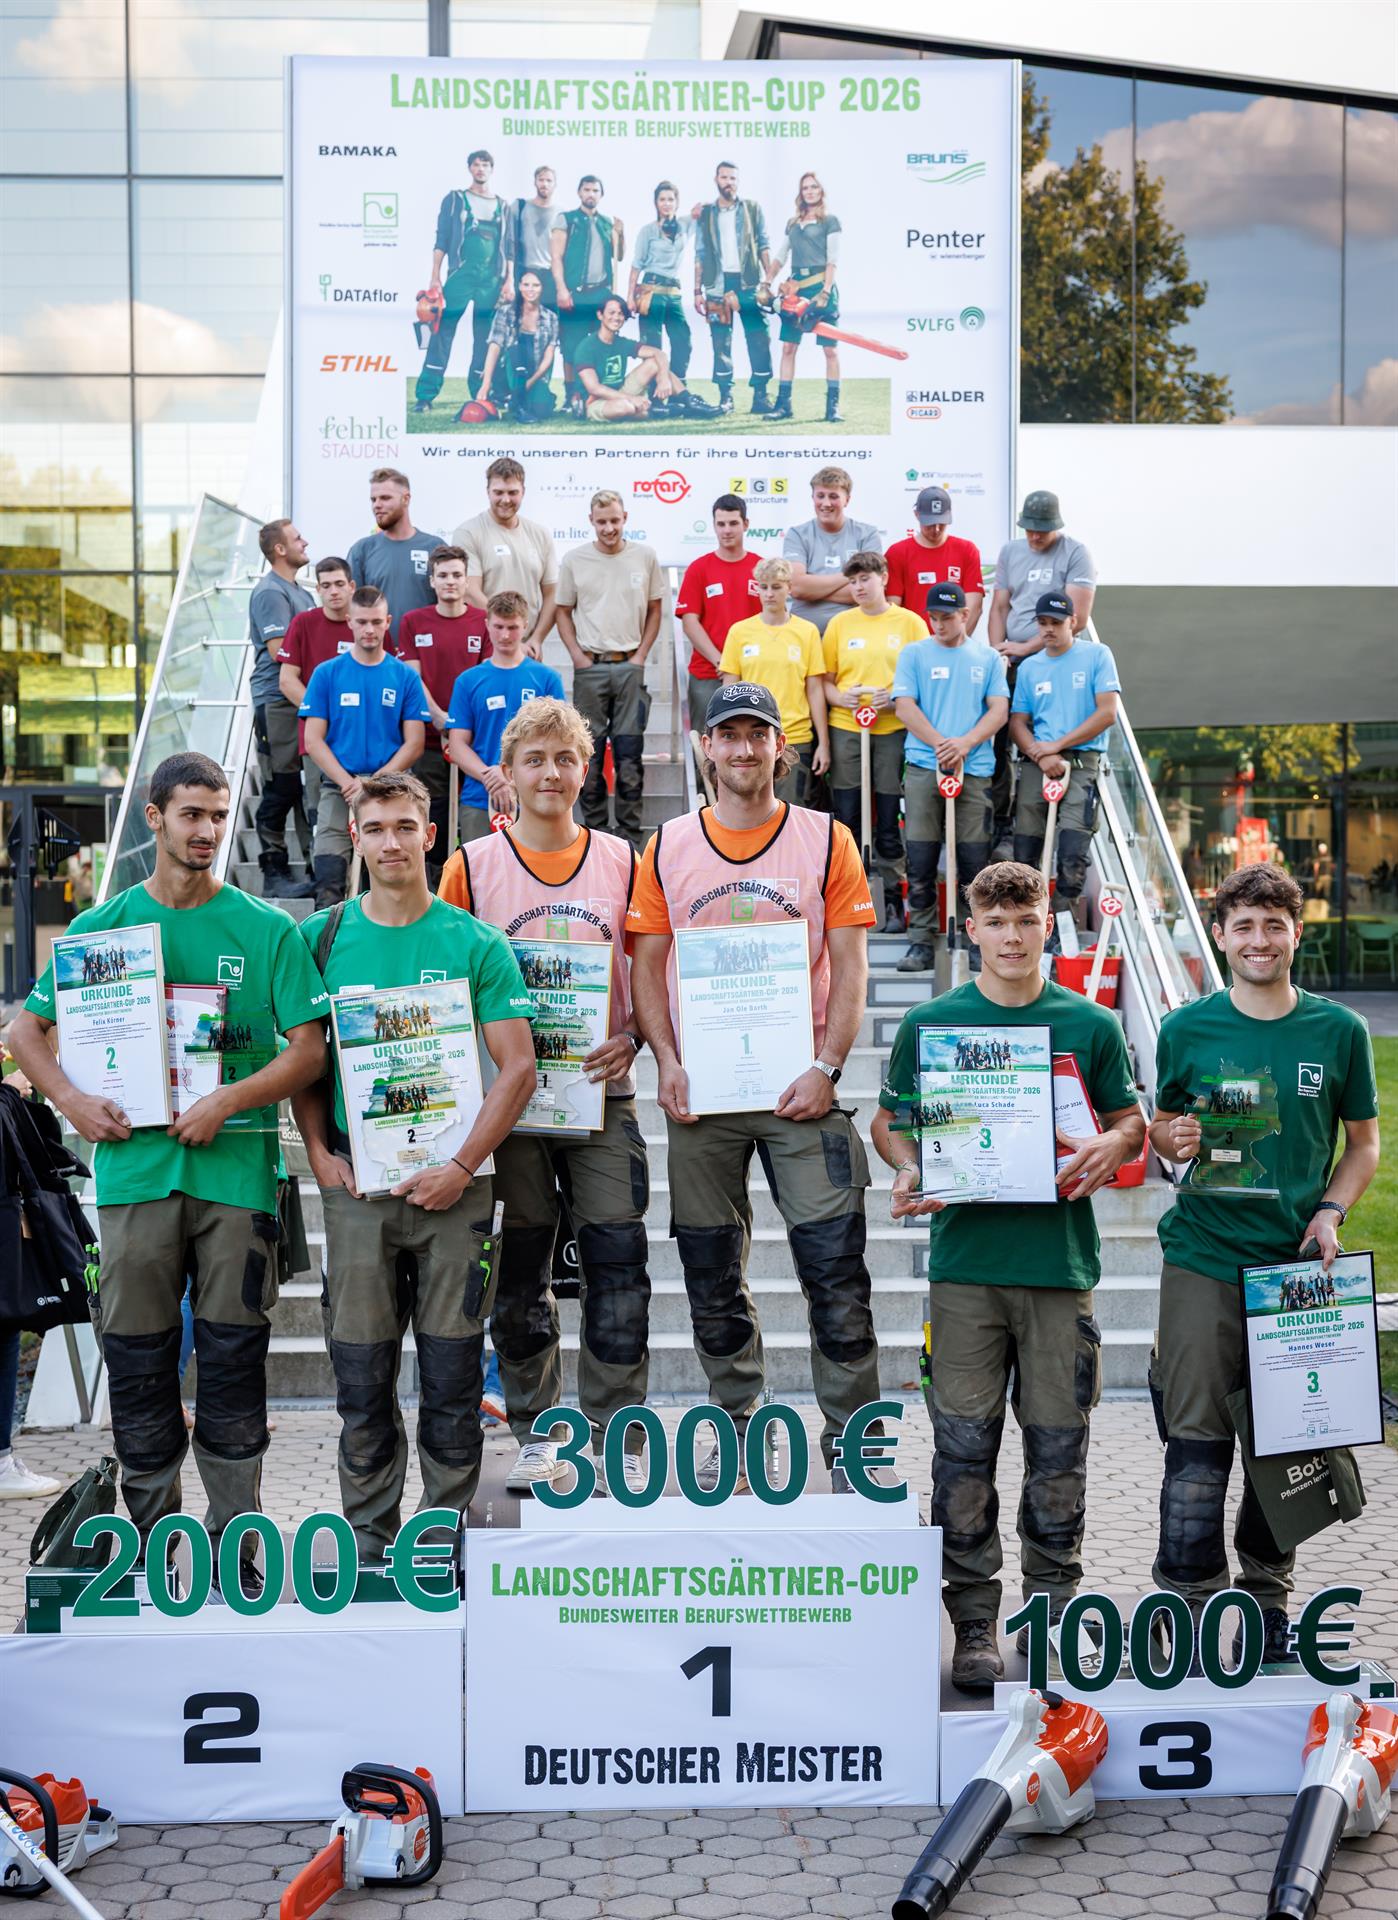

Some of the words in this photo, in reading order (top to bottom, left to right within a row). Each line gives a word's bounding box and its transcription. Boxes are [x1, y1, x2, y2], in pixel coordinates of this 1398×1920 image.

[390, 71, 825, 112] LANDSCHAFTSGÄRTNER-CUP
[839, 77, 921, 112] 2026
[502, 118, 628, 137] BUNDESWEITER
[635, 119, 811, 138] BERUFSWETTBEWERB
[318, 145, 398, 157] BAMAKA
[907, 229, 985, 248] Penter
[333, 289, 399, 303] DATAflor
[906, 318, 955, 332] SVLFG
[320, 355, 399, 373] STIHL
[919, 390, 985, 403] HALDER
[319, 416, 399, 440] fehrle
[321, 443, 399, 459] STAUDEN
[422, 446, 451, 458] Wir
[457, 447, 515, 459] danken
[522, 448, 588, 459] unseren
[595, 447, 669, 459] Partnern
[676, 447, 700, 459] für
[706, 447, 738, 459] ihre
[745, 447, 873, 461] Unterstützung:
[633, 473, 692, 501] rotary
[504, 902, 613, 940] ANDSCHAFTSGÄRTNER-CUP
[710, 975, 777, 990] URKUNDE
[81, 984, 133, 1002] URKUNDE
[136, 995, 151, 1006] 2026
[531, 991, 577, 1005] KUNDE
[580, 1007, 597, 1016] 2026
[93, 1017, 107, 1026] Felix
[373, 1039, 442, 1059] URKUNDE
[448, 1049, 466, 1060] 2026
[228, 1066, 237, 1080] 2
[951, 1074, 1018, 1086] URKUNDE
[1023, 1087, 1041, 1095] 2026
[991, 1101, 1015, 1109] Schade
[407, 1129, 416, 1144] 2
[1225, 1131, 1233, 1145] 3
[933, 1140, 942, 1154] 3
[1276, 1309, 1343, 1328] URKUNDE
[1256, 1323, 1346, 1341] LANDSCHAFTSGÄRTNER-CUP
[1347, 1321, 1365, 1331] 2026
[1288, 1343, 1313, 1352] Hannes
[1315, 1340, 1336, 1349] Weser
[529, 1402, 810, 1510] 3000
[832, 1399, 909, 1504] €
[1280, 1480, 1313, 1501] Pflanzen
[72, 1511, 360, 1618] 2000
[382, 1507, 461, 1613] €
[491, 1557, 919, 1598] LANDSCHAFTSGÄRTNER-CUP
[559, 1606, 679, 1624] BUNDESWEITER
[684, 1606, 852, 1624] BERUFSWETTBEWERB
[1002, 1588, 1265, 1693] 1000
[1286, 1585, 1364, 1687] €
[679, 1645, 732, 1717] 1
[183, 1691, 261, 1764] 2
[524, 1744, 721, 1786] DEUTSCHER
[735, 1742, 883, 1783] MEISTER
[1138, 1720, 1213, 1791] 3
